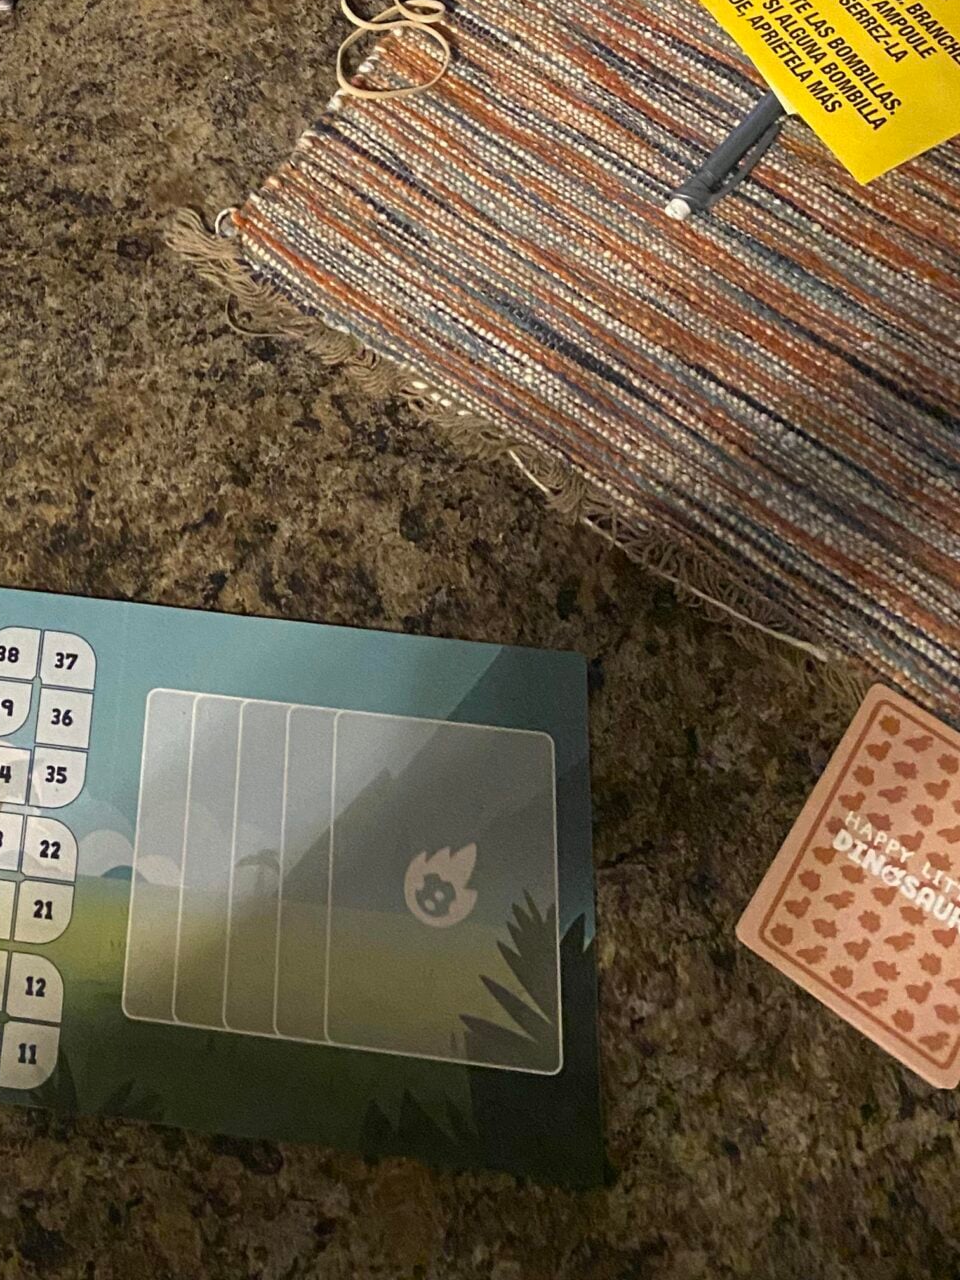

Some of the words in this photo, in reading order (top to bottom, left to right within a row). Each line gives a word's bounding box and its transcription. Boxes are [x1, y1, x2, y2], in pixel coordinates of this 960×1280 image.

[872, 1, 937, 58] AMPOULE
[748, 16, 813, 82] APRIÉTELA
[807, 80, 842, 112] MÁS
[763, 0, 784, 14] SI
[775, 15, 827, 64] ALGUNA
[820, 62, 886, 130] BOMBILLA
[804, 12, 834, 37] LAS
[828, 38, 901, 115] BOMBILLAS.
[55, 652, 78, 670] 37
[46, 766, 67, 784] 35
[845, 810, 915, 865] HAPPY
[832, 828, 960, 930] DINOSAUR
[26, 976, 46, 997] 12
[18, 1043, 36, 1065] 11
